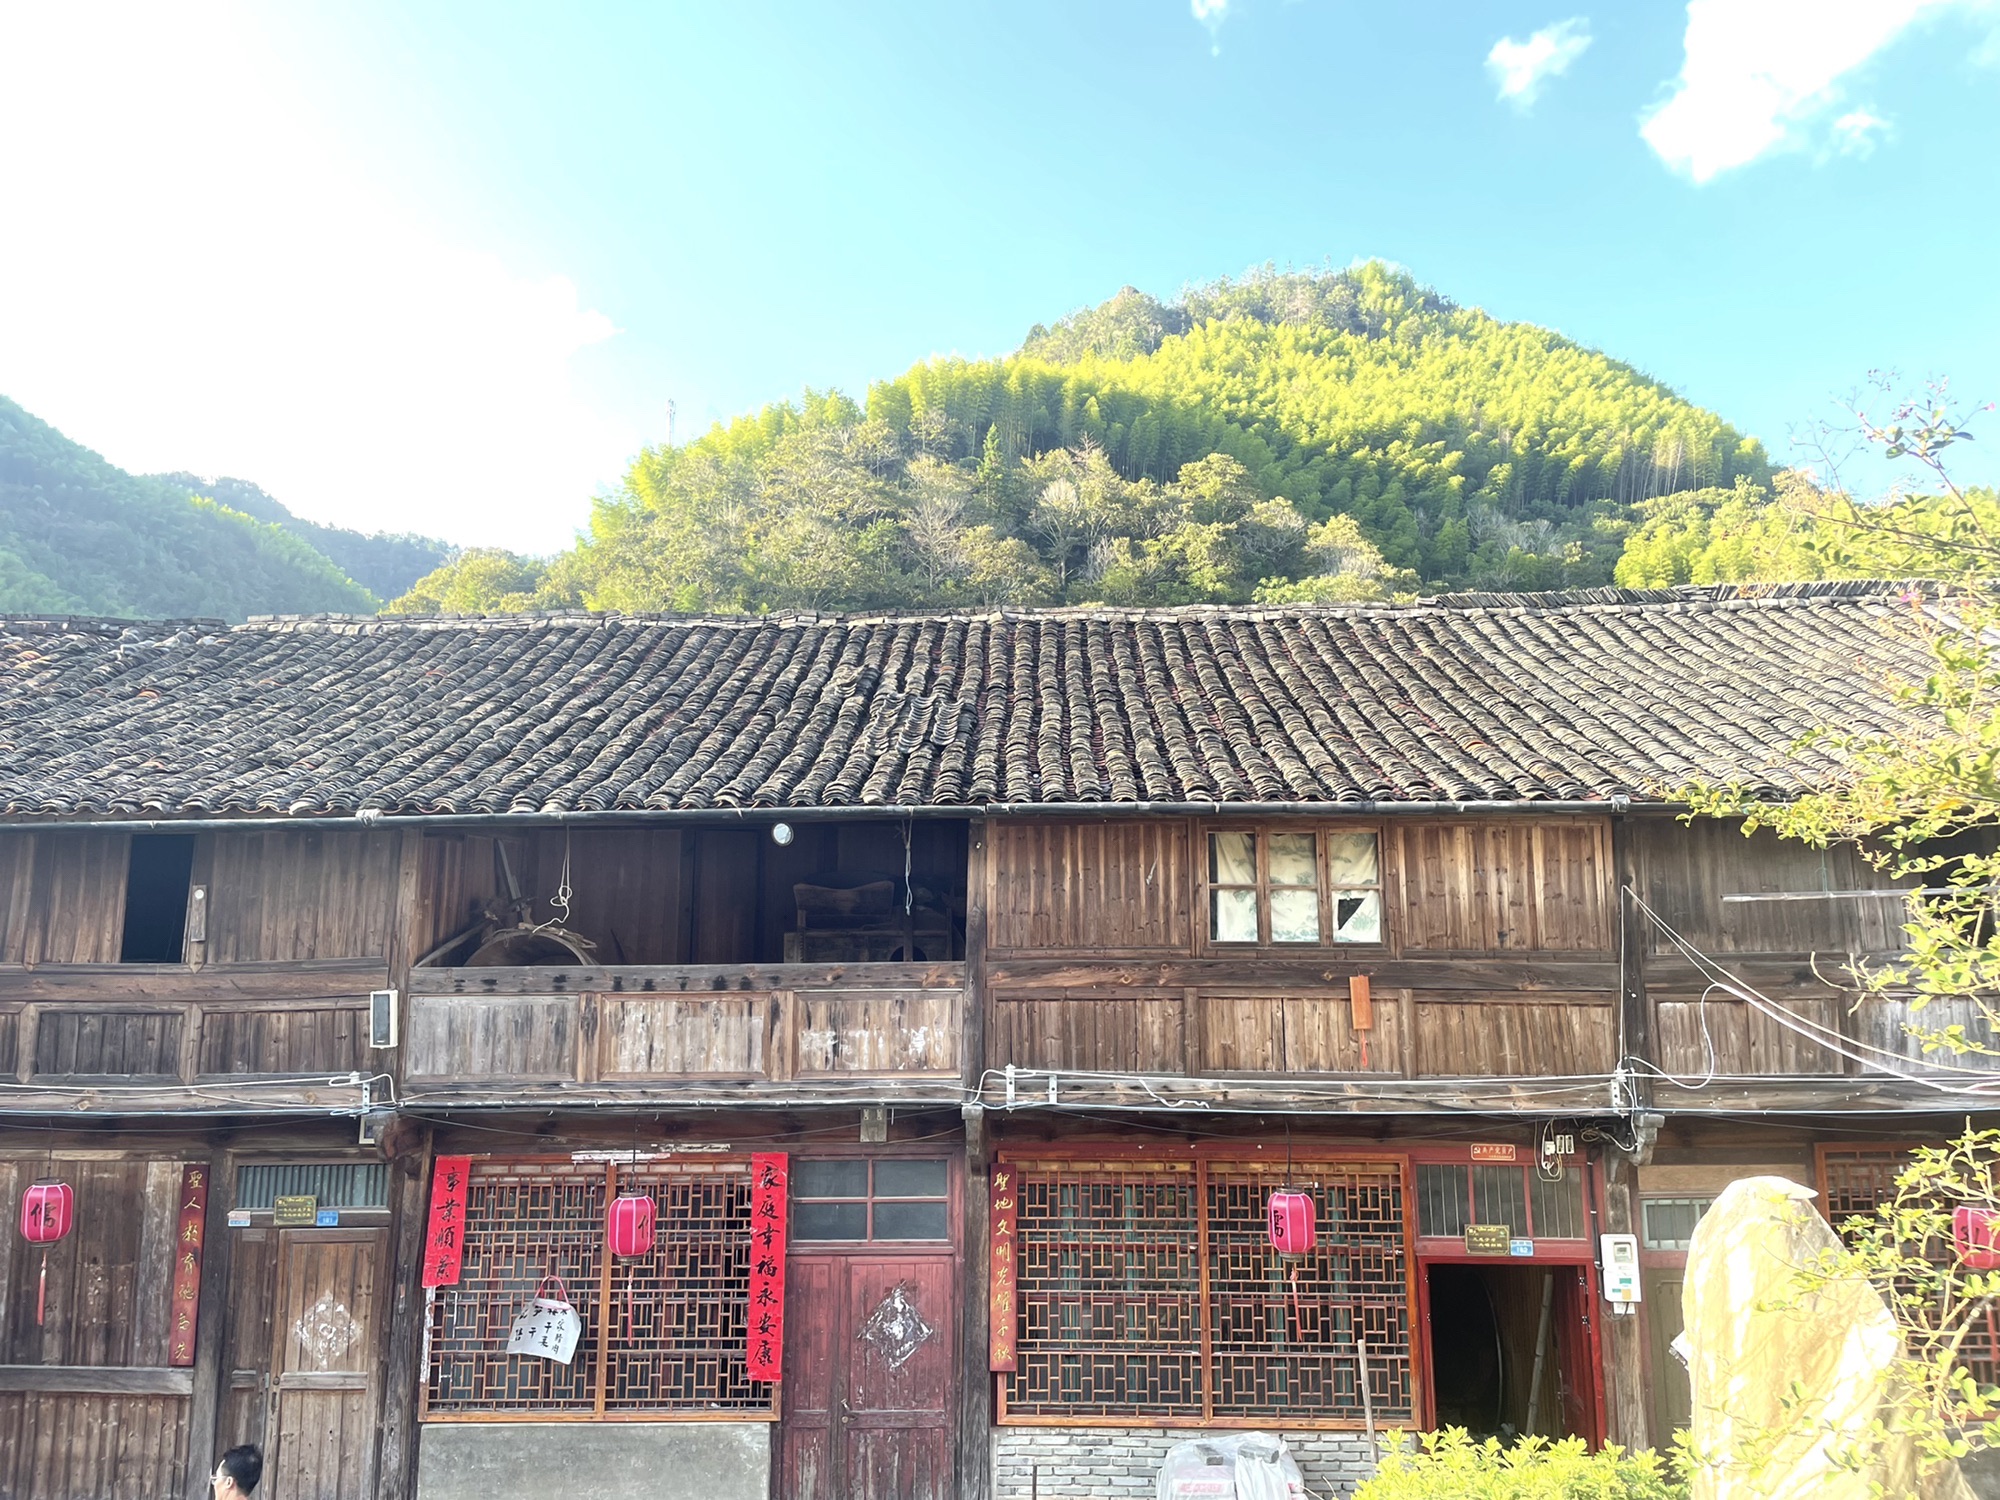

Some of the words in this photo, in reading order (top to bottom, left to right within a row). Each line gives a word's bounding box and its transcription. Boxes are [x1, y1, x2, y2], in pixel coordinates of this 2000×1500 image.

[752, 1161, 782, 1367] 家庭幸福永安康
